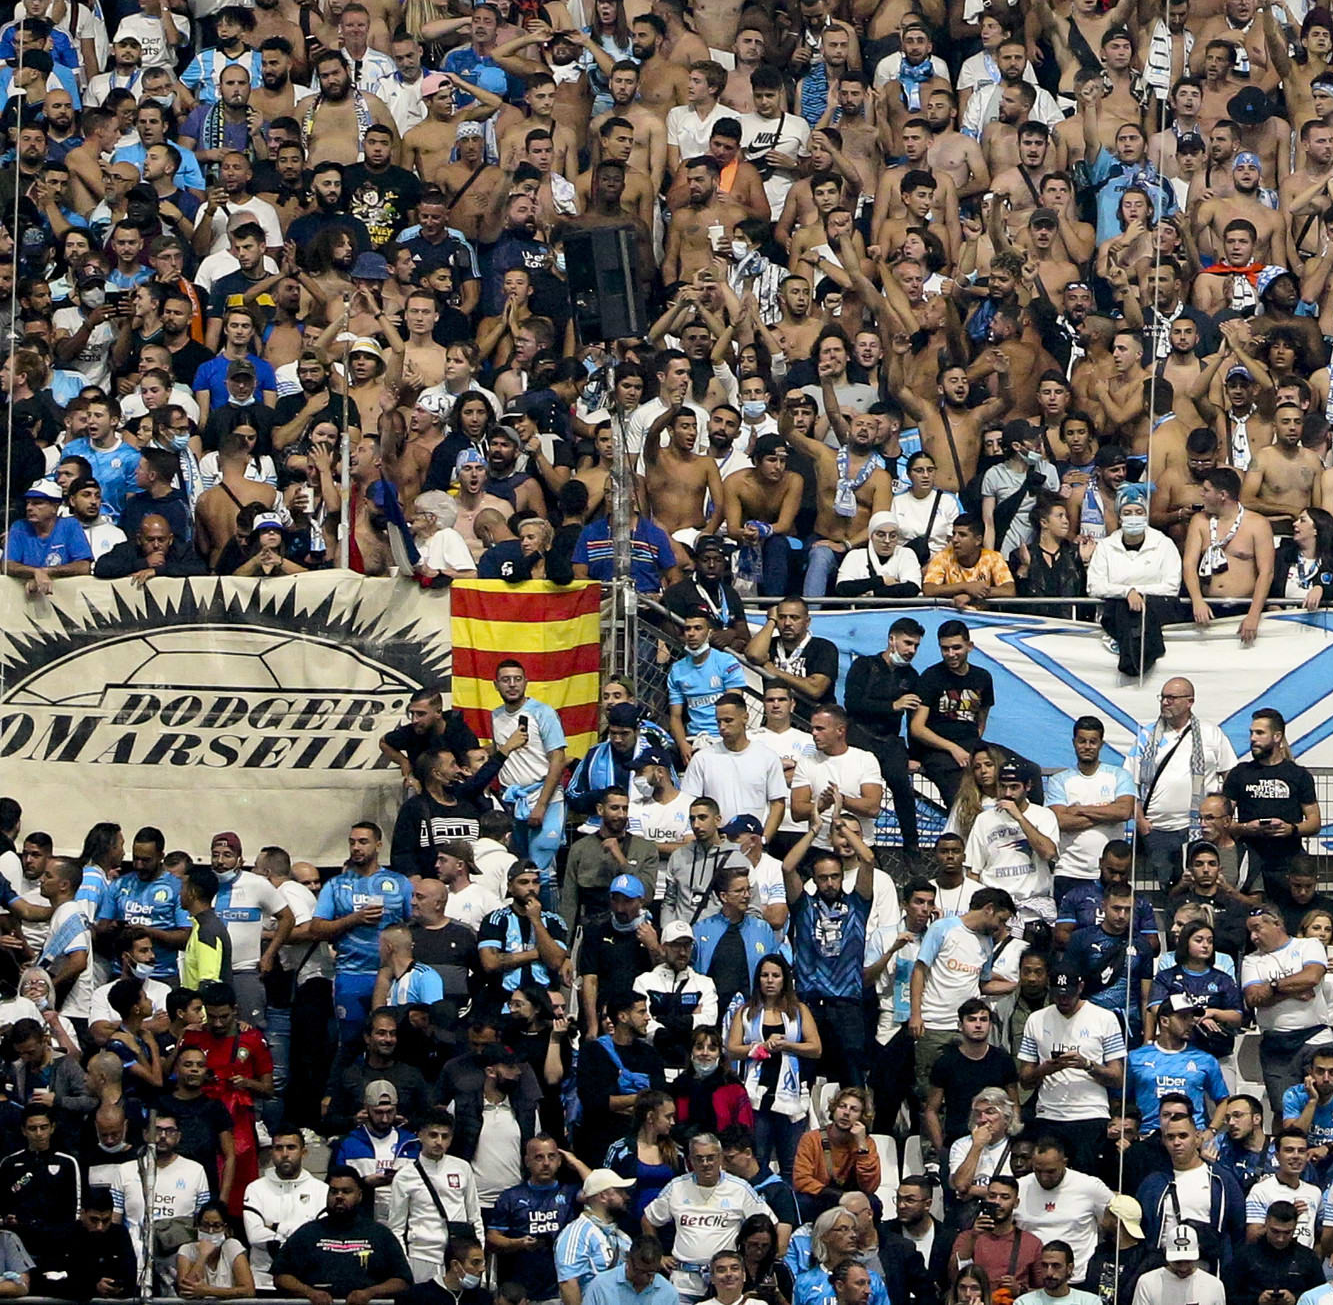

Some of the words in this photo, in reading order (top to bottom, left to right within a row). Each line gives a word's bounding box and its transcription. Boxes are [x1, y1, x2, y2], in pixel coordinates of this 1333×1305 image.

[1245, 785, 1275, 793] NORTH
[1256, 791, 1276, 799] FACE
[648, 831, 677, 844] Uber
[125, 901, 154, 914] Uber
[1052, 1042, 1079, 1054] Uber
[1156, 1076, 1185, 1086] Uber
[155, 1192, 176, 1205] ber
[529, 1211, 558, 1222] Uber
[529, 1221, 559, 1234] Eats
[1293, 1227, 1312, 1239] ats
